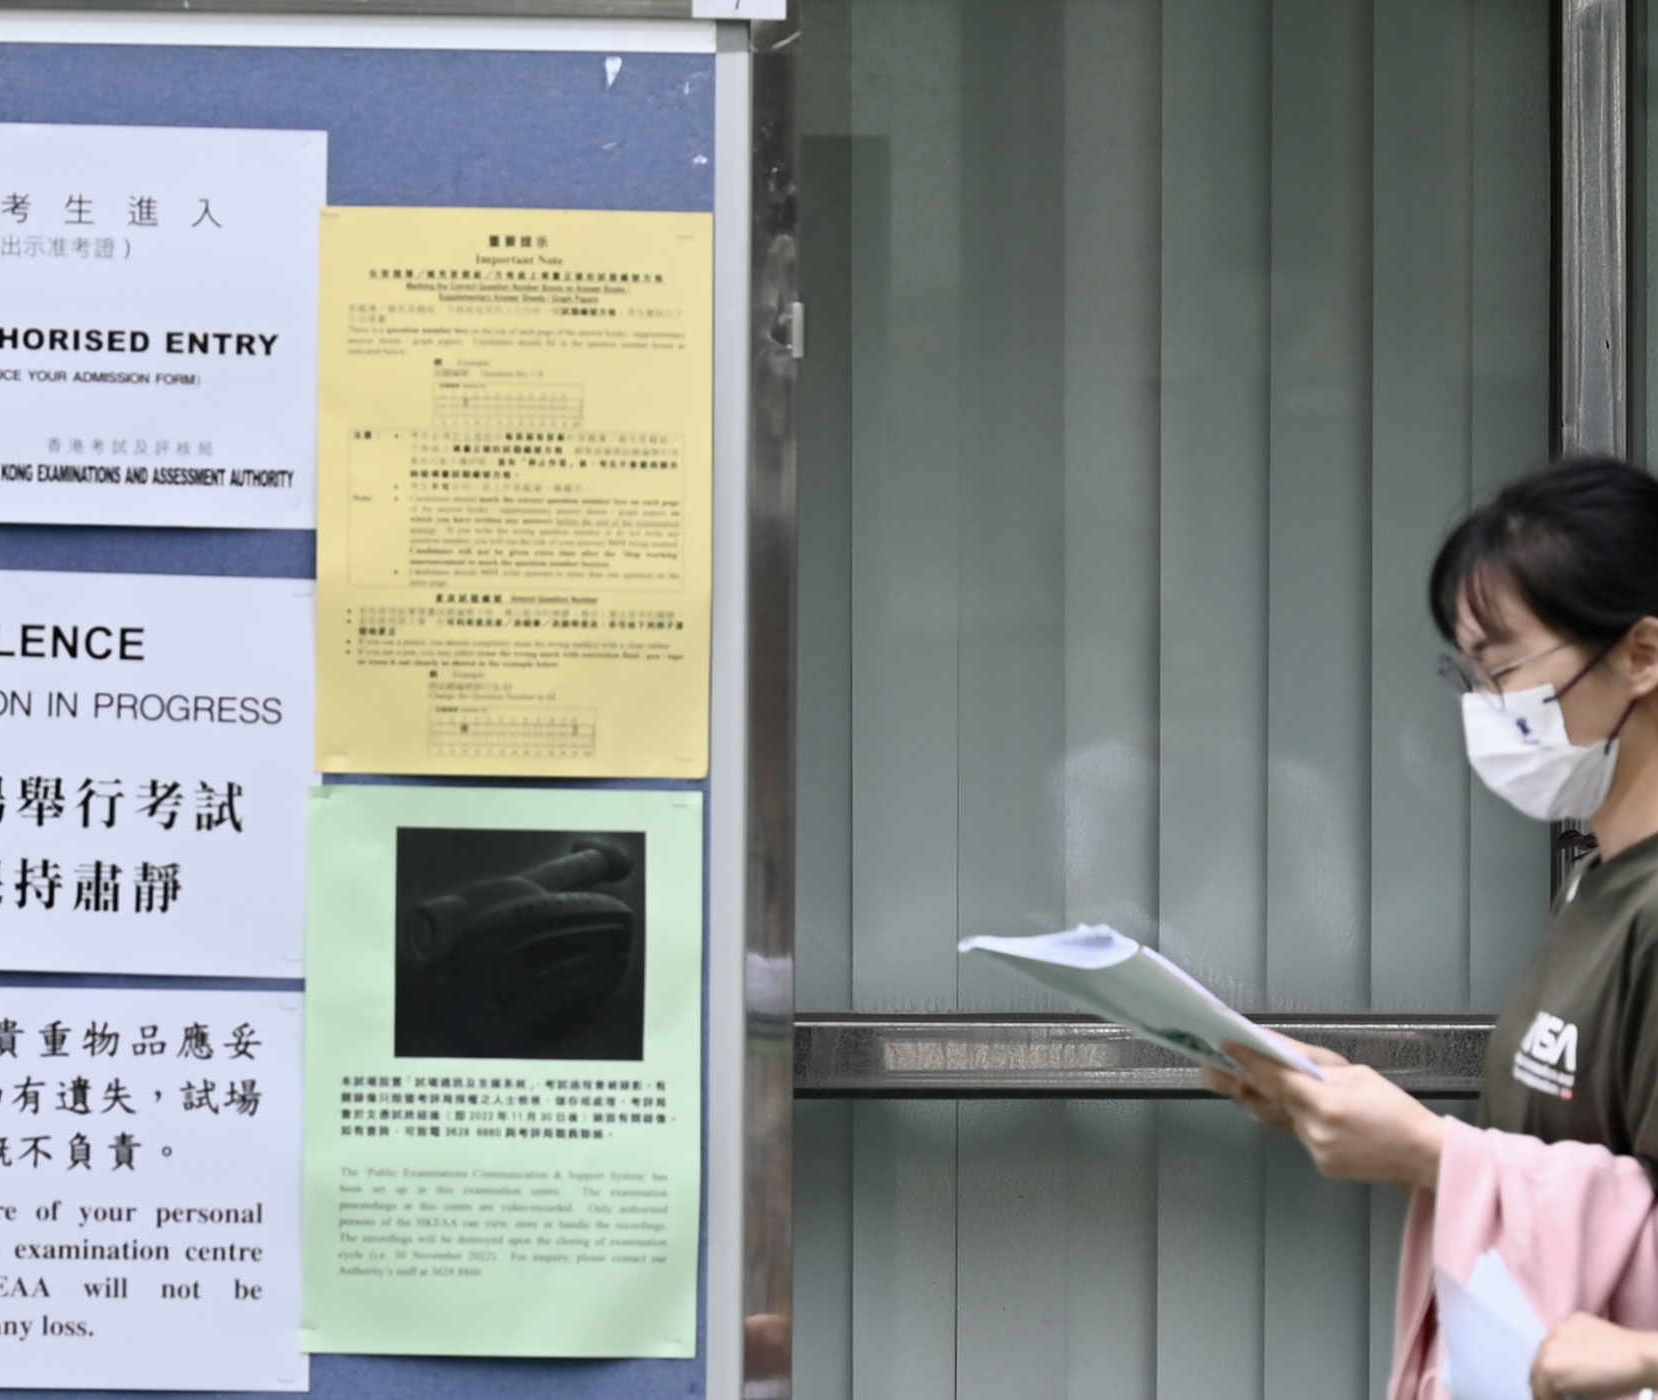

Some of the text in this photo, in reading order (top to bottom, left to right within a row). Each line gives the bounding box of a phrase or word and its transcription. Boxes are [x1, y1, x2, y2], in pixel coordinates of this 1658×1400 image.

[475, 254, 563, 266] Important Note
[165, 332, 277, 355] ENTRY
[28, 370, 67, 382] YOUR
[72, 371, 150, 384] ADMISSION
[154, 373, 201, 385] FORM)
[1, 463, 33, 481] KONG
[37, 464, 121, 483] EXAMINATIONS
[124, 466, 148, 484] AND
[152, 467, 226, 485] ASSESSMENT
[229, 469, 293, 487] AUTHORITY
[47, 691, 77, 717] IN
[94, 692, 282, 724] PROGRESS
[35, 1200, 61, 1221] of
[78, 1207, 137, 1226] your
[156, 1203, 262, 1227] personal
[14, 1239, 169, 1260] examination
[185, 1244, 262, 1261] centre
[84, 1277, 127, 1298] will
[161, 1281, 199, 1299] not
[234, 1279, 261, 1299] be
[42, 1314, 93, 1336] loss.
